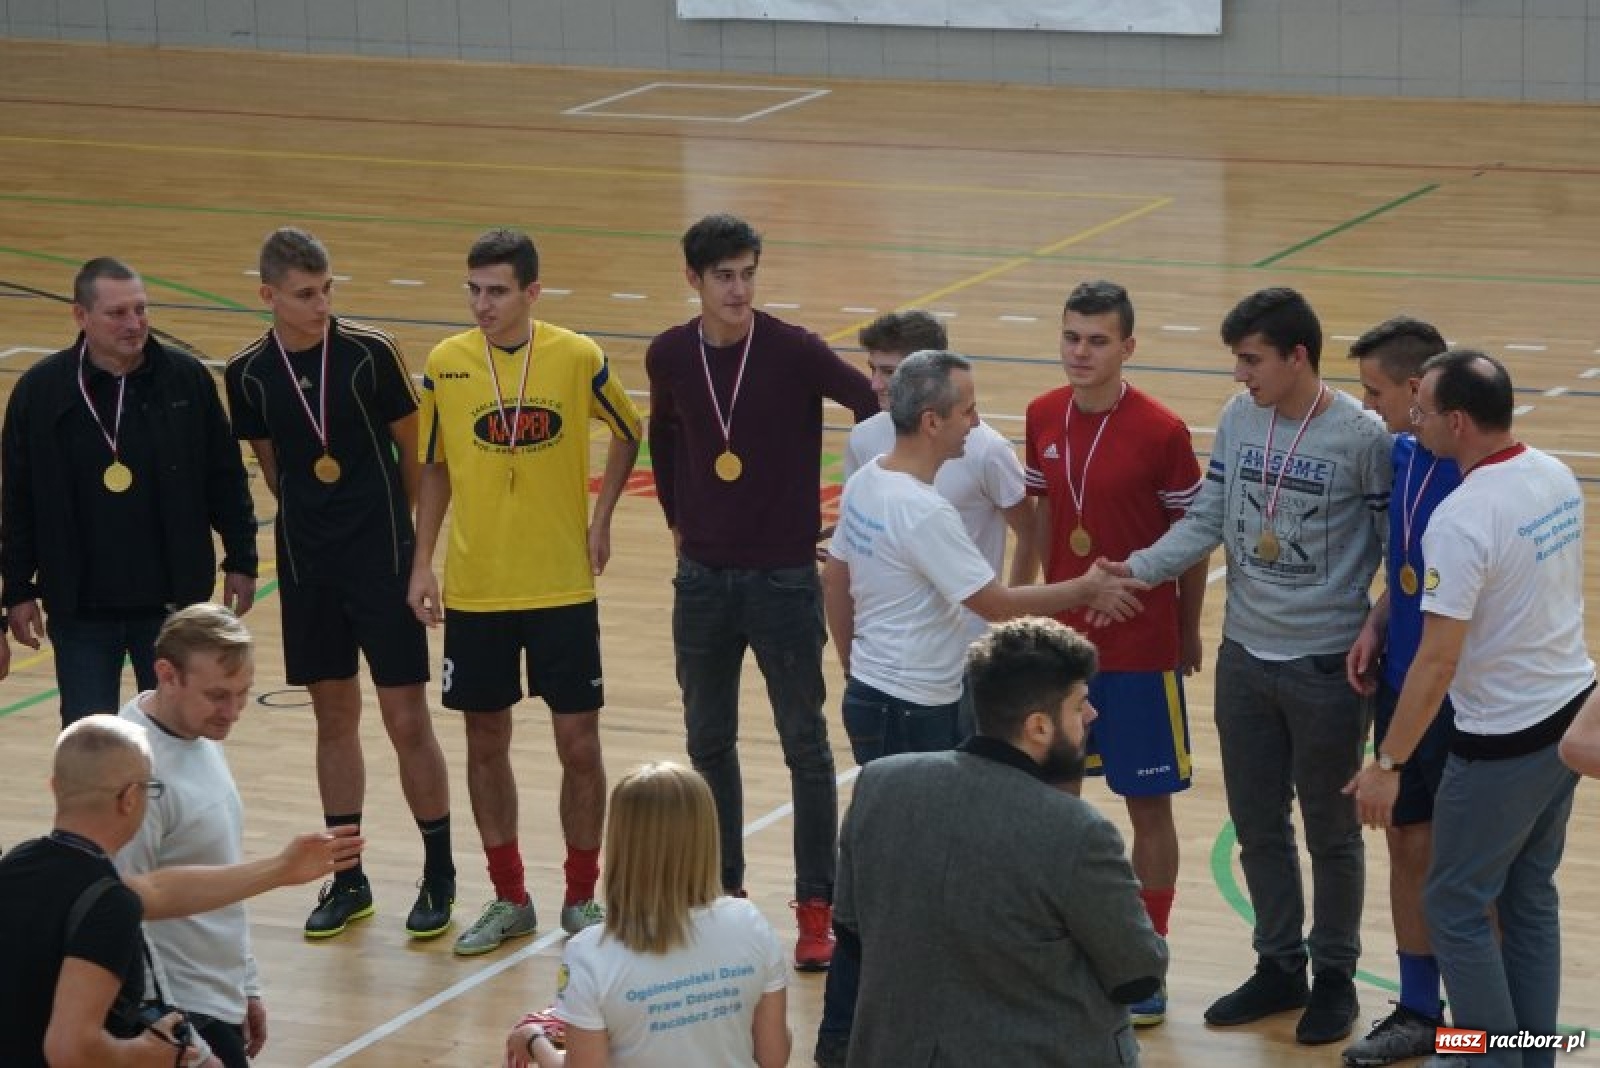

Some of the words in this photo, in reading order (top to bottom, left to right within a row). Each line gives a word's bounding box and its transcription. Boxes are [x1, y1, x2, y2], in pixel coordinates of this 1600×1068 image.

[1241, 449, 1328, 481] AWSOME
[625, 972, 715, 1002] Ogólnopolski
[685, 987, 740, 1005] Dziecka
